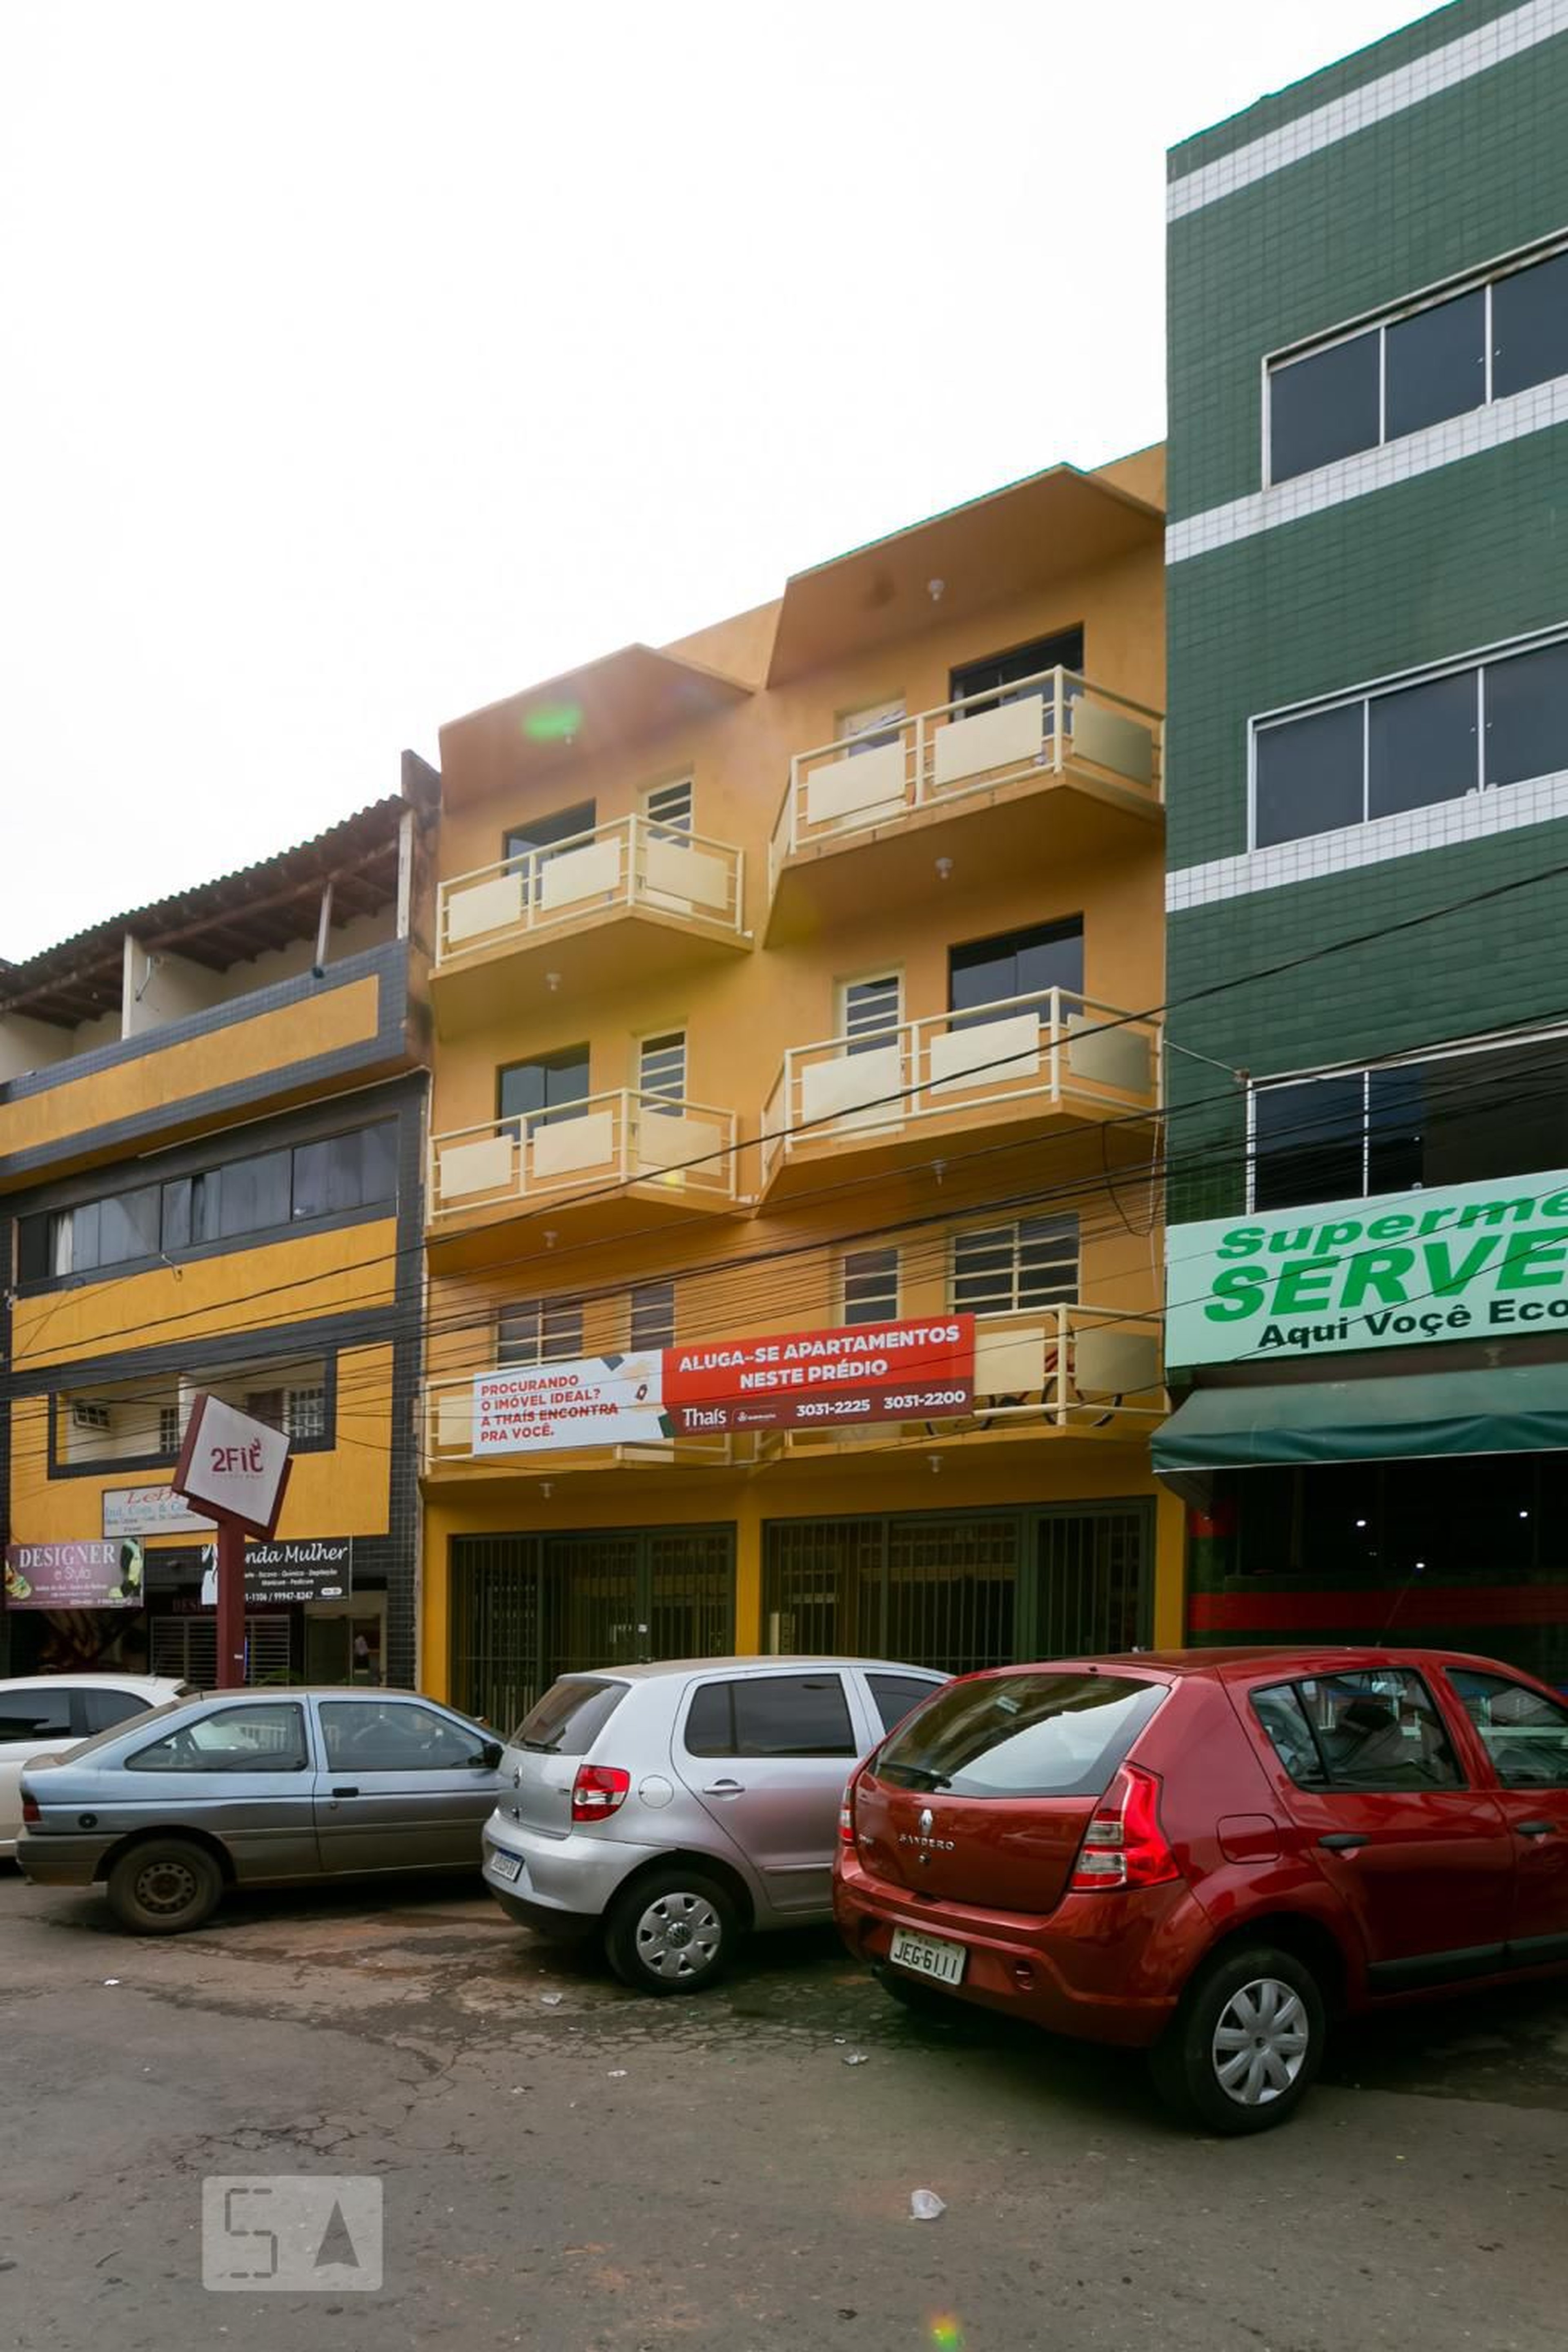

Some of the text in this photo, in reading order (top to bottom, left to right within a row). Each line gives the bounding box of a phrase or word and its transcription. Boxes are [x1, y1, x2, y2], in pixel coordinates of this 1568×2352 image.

[1258, 1317, 1348, 1348] Aqui
[679, 1324, 960, 1372] ALUGA-SE APARTAMENTOS
[481, 1374, 579, 1396] PROCURANDO
[740, 1359, 888, 1389] NESTE PRÉDIO
[481, 1389, 601, 1411] O IMÓVEL IDEAL?
[682, 1408, 727, 1427] Thaís
[796, 1399, 870, 1417] 3031-2225
[884, 1390, 966, 1410] 3031-2200
[481, 1403, 619, 1427] A THAÍS ENCONTRA
[481, 1425, 554, 1442] PRA VOCÊ.
[20, 1544, 116, 1568] DESIGNER
[285, 1543, 348, 1564] Mulher
